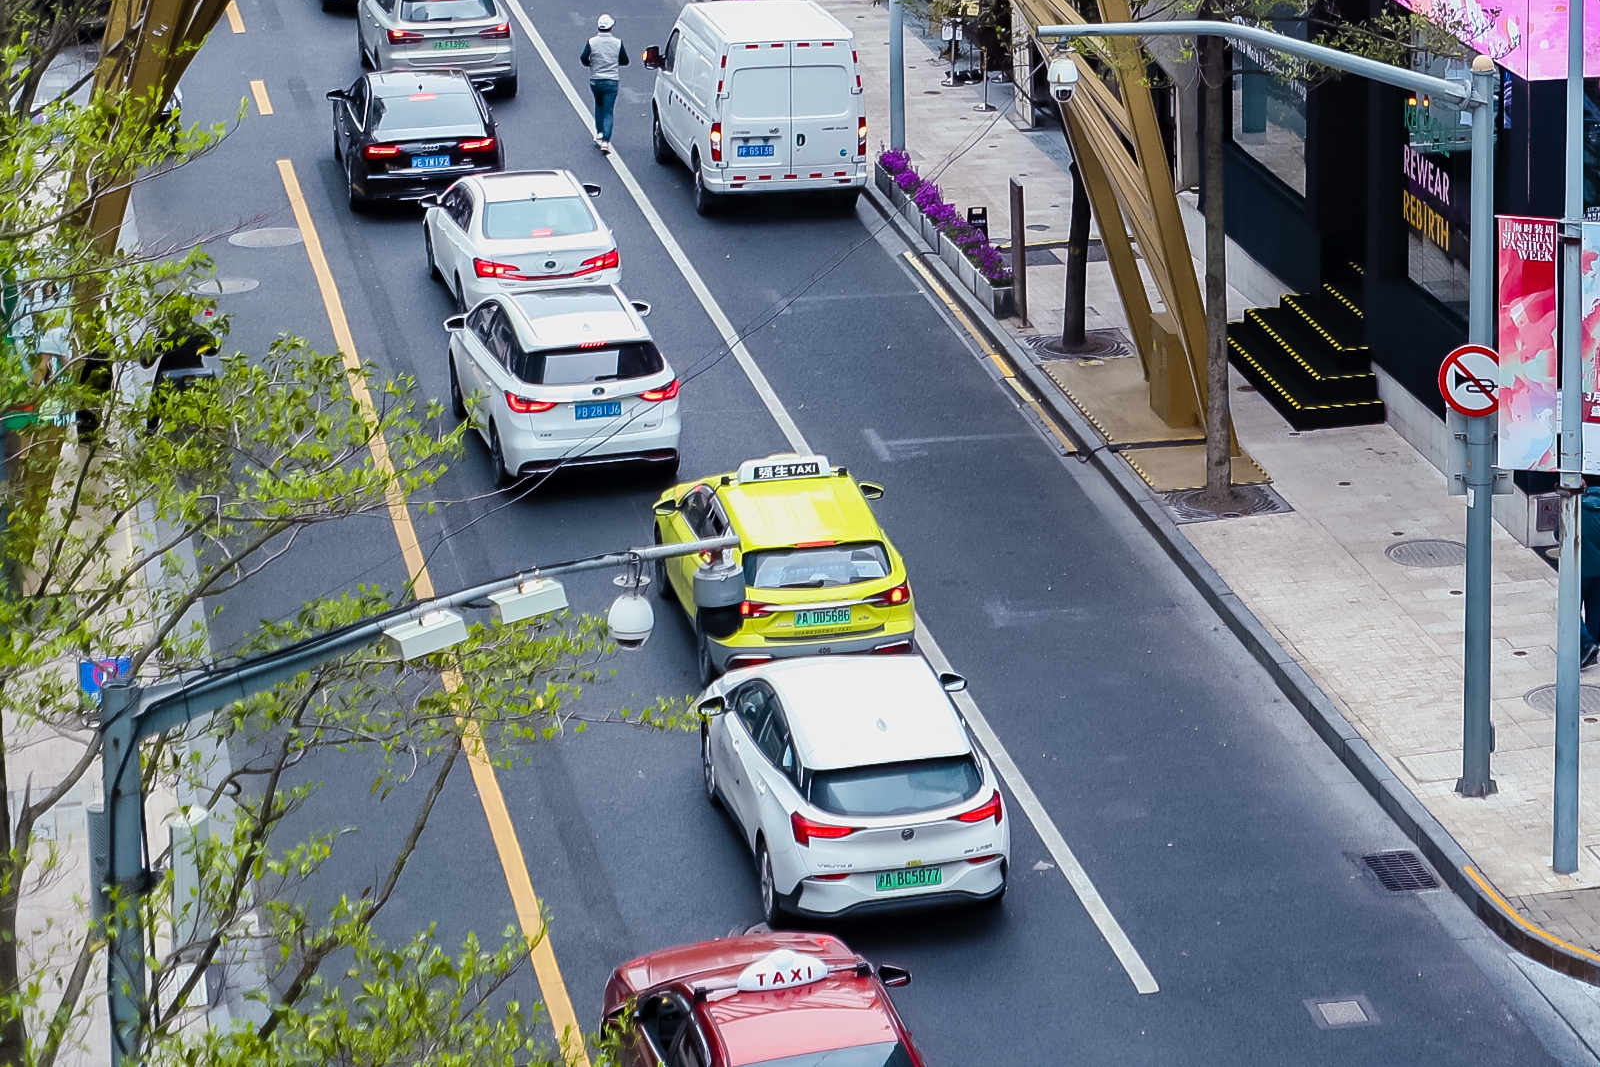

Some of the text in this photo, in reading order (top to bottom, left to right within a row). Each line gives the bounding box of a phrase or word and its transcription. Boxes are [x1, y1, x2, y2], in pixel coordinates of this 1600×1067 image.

[1403, 144, 1450, 206] REWEAR
[1402, 189, 1450, 252] REBIRTH
[1502, 221, 1555, 234] 上海时装周
[1501, 231, 1554, 243] SHANGHAI
[1501, 240, 1554, 253] FASHION
[1517, 249, 1554, 262] WEEK
[818, 646, 832, 654] 406
[755, 965, 812, 987] TAXI
